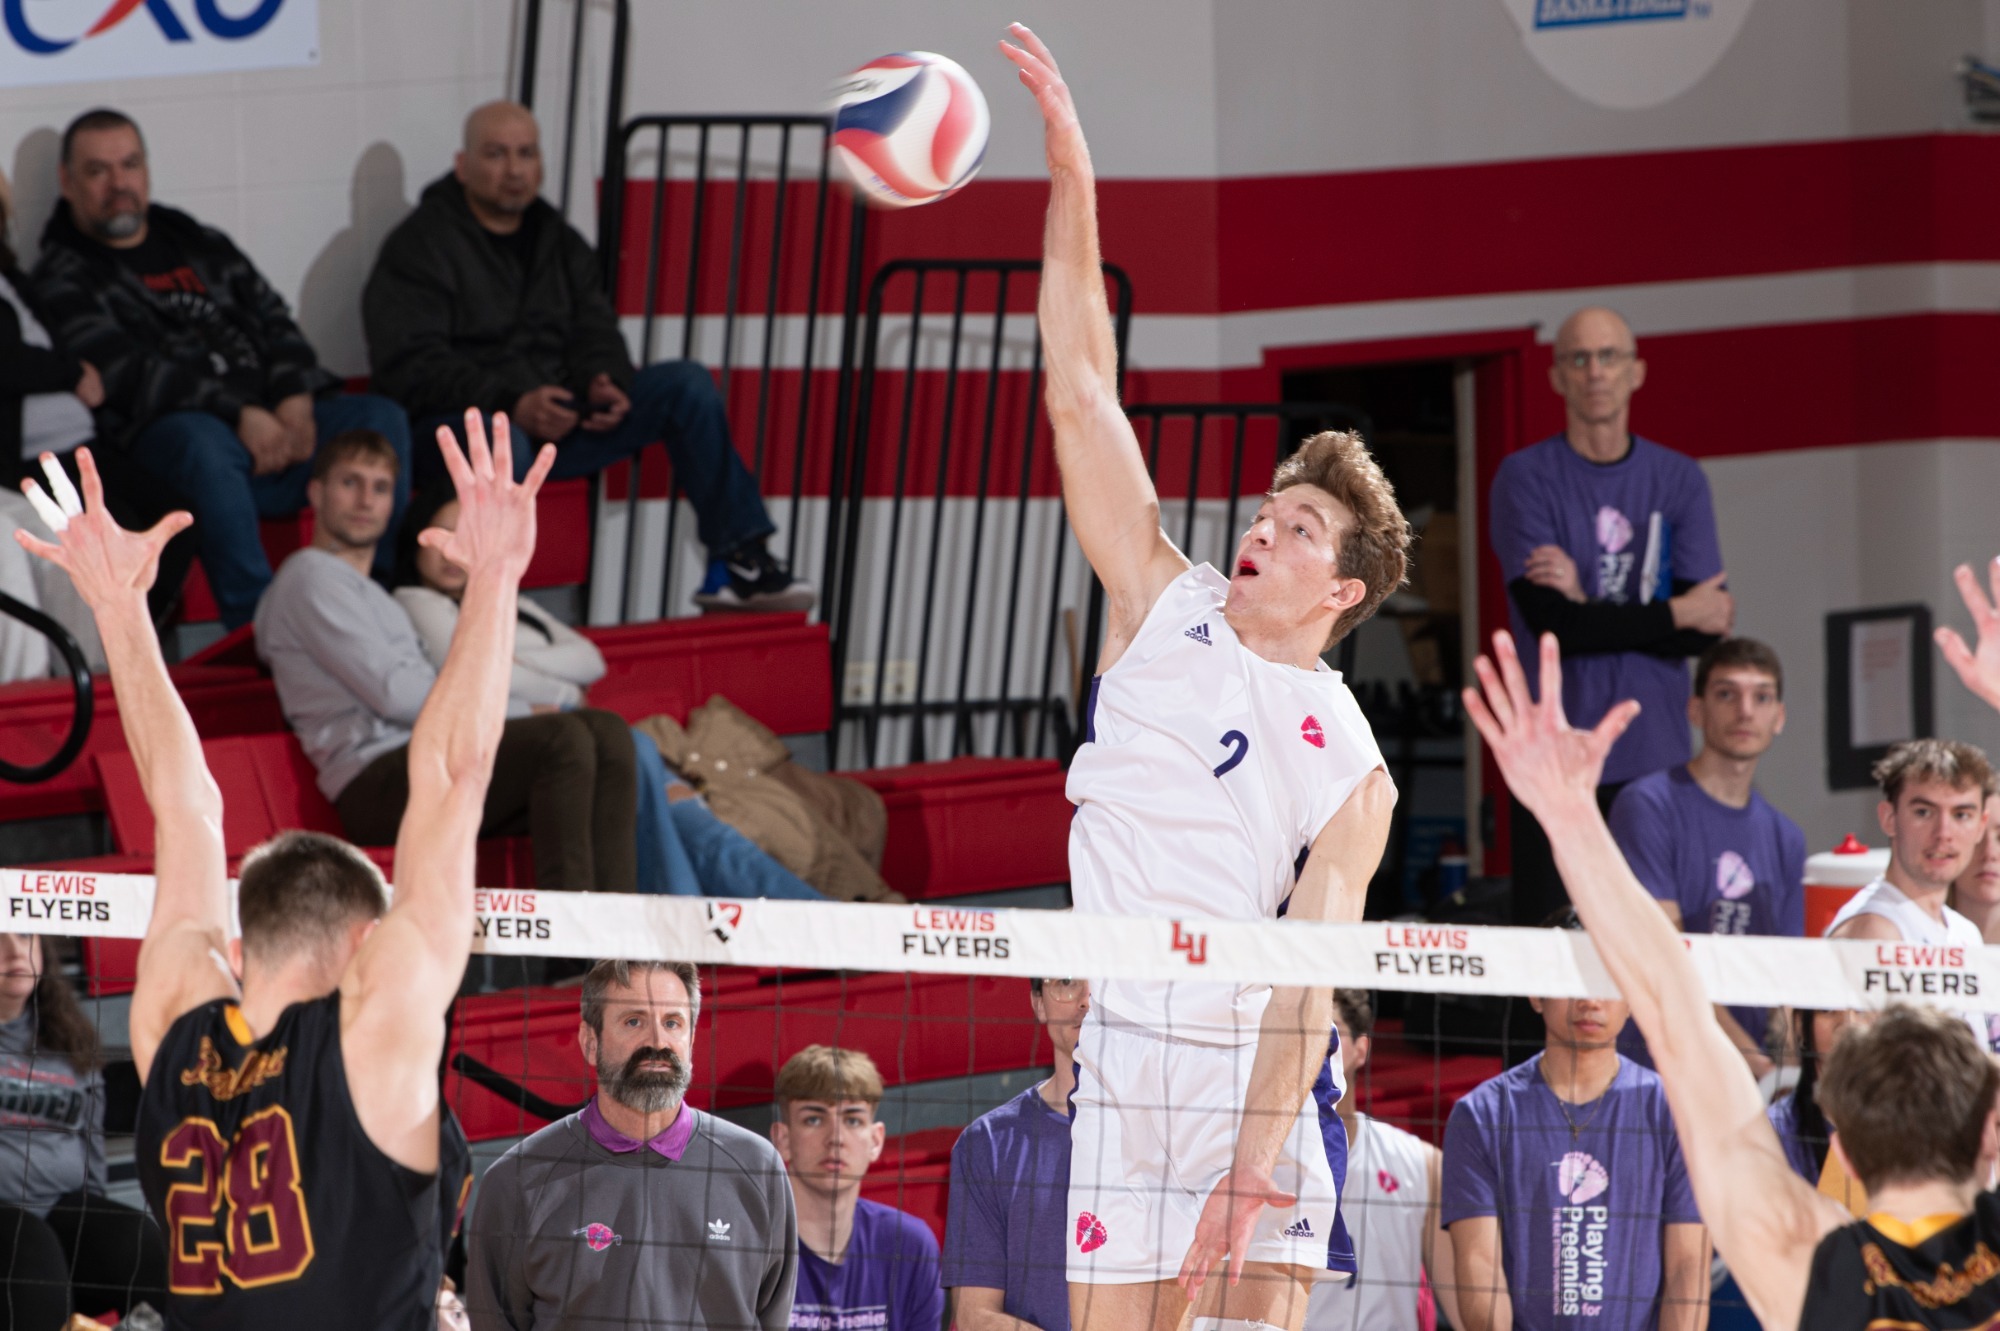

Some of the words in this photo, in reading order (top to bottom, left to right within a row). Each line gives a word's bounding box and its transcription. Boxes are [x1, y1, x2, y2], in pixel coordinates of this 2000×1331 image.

[1213, 729, 1249, 778] 2
[20, 874, 97, 896] LEWIS
[10, 898, 110, 922] FLYERS
[475, 892, 535, 913] EWIS
[474, 917, 550, 939] YERS
[913, 909, 995, 933] LEWIS
[903, 934, 1009, 959] FLYERS
[1171, 920, 1207, 965] LU
[1386, 928, 1467, 951] LEWIS
[1375, 952, 1485, 976] FLYERS
[1876, 945, 1964, 967] LEWIS
[1865, 970, 1978, 995] FLYERS
[161, 1105, 314, 1294] 28
[1284, 1228, 1315, 1238] adidas
[1561, 1206, 1584, 1316] Preemies
[1581, 1206, 1608, 1301] Playing
[1582, 1303, 1602, 1316] for
